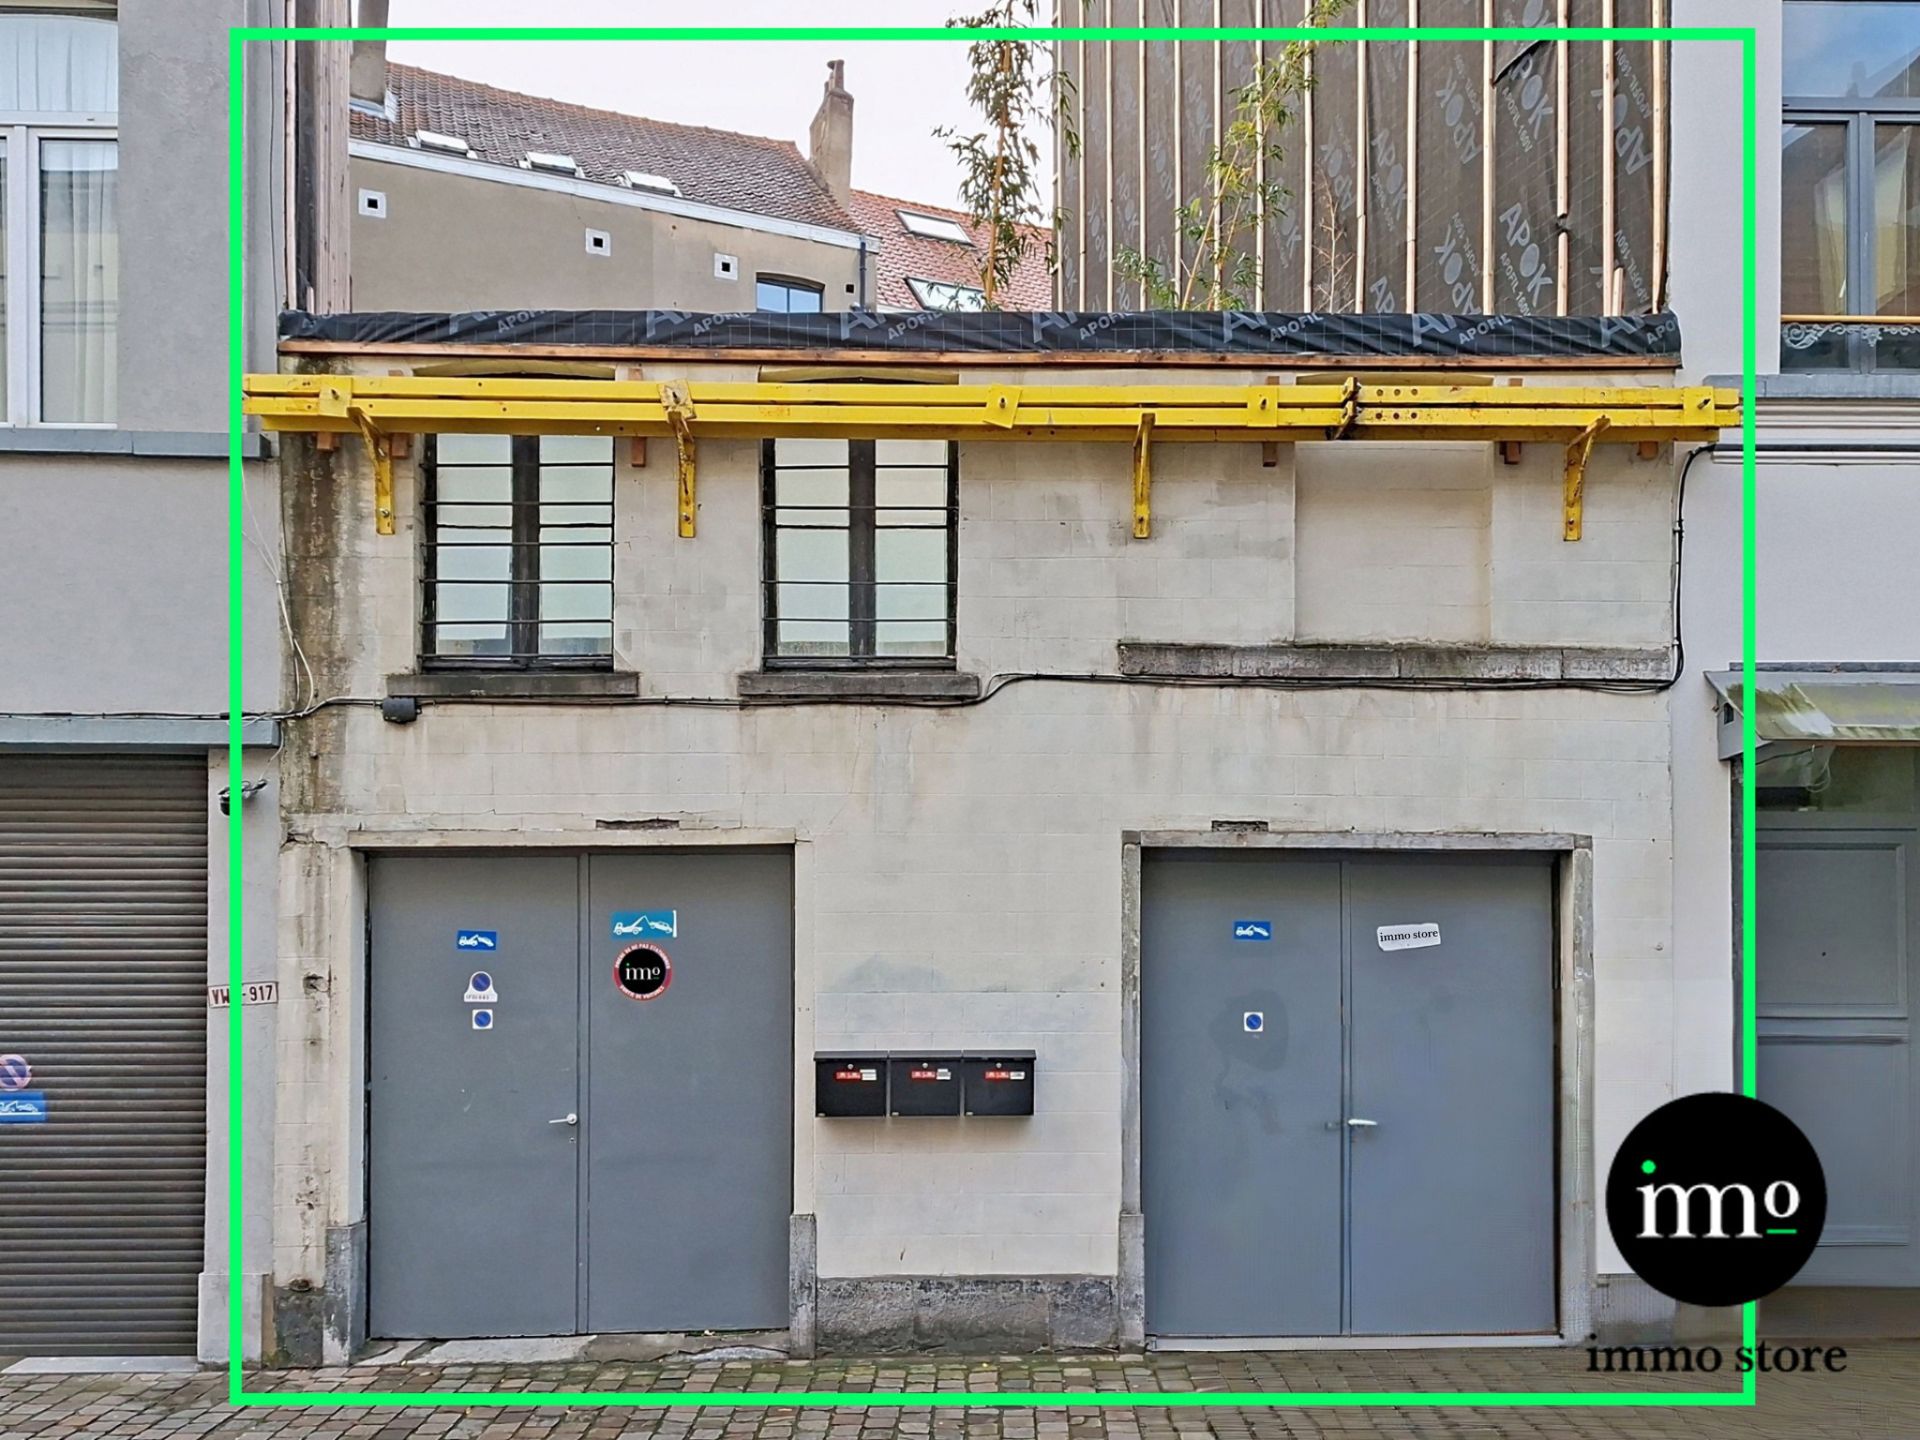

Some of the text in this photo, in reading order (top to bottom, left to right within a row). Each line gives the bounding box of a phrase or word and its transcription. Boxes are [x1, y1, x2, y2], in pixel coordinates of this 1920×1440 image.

[1435, 67, 1482, 164] APOK
[1499, 202, 1554, 308] APOK
[1458, 314, 1512, 344] APOFIL
[1380, 930, 1438, 942] immo store
